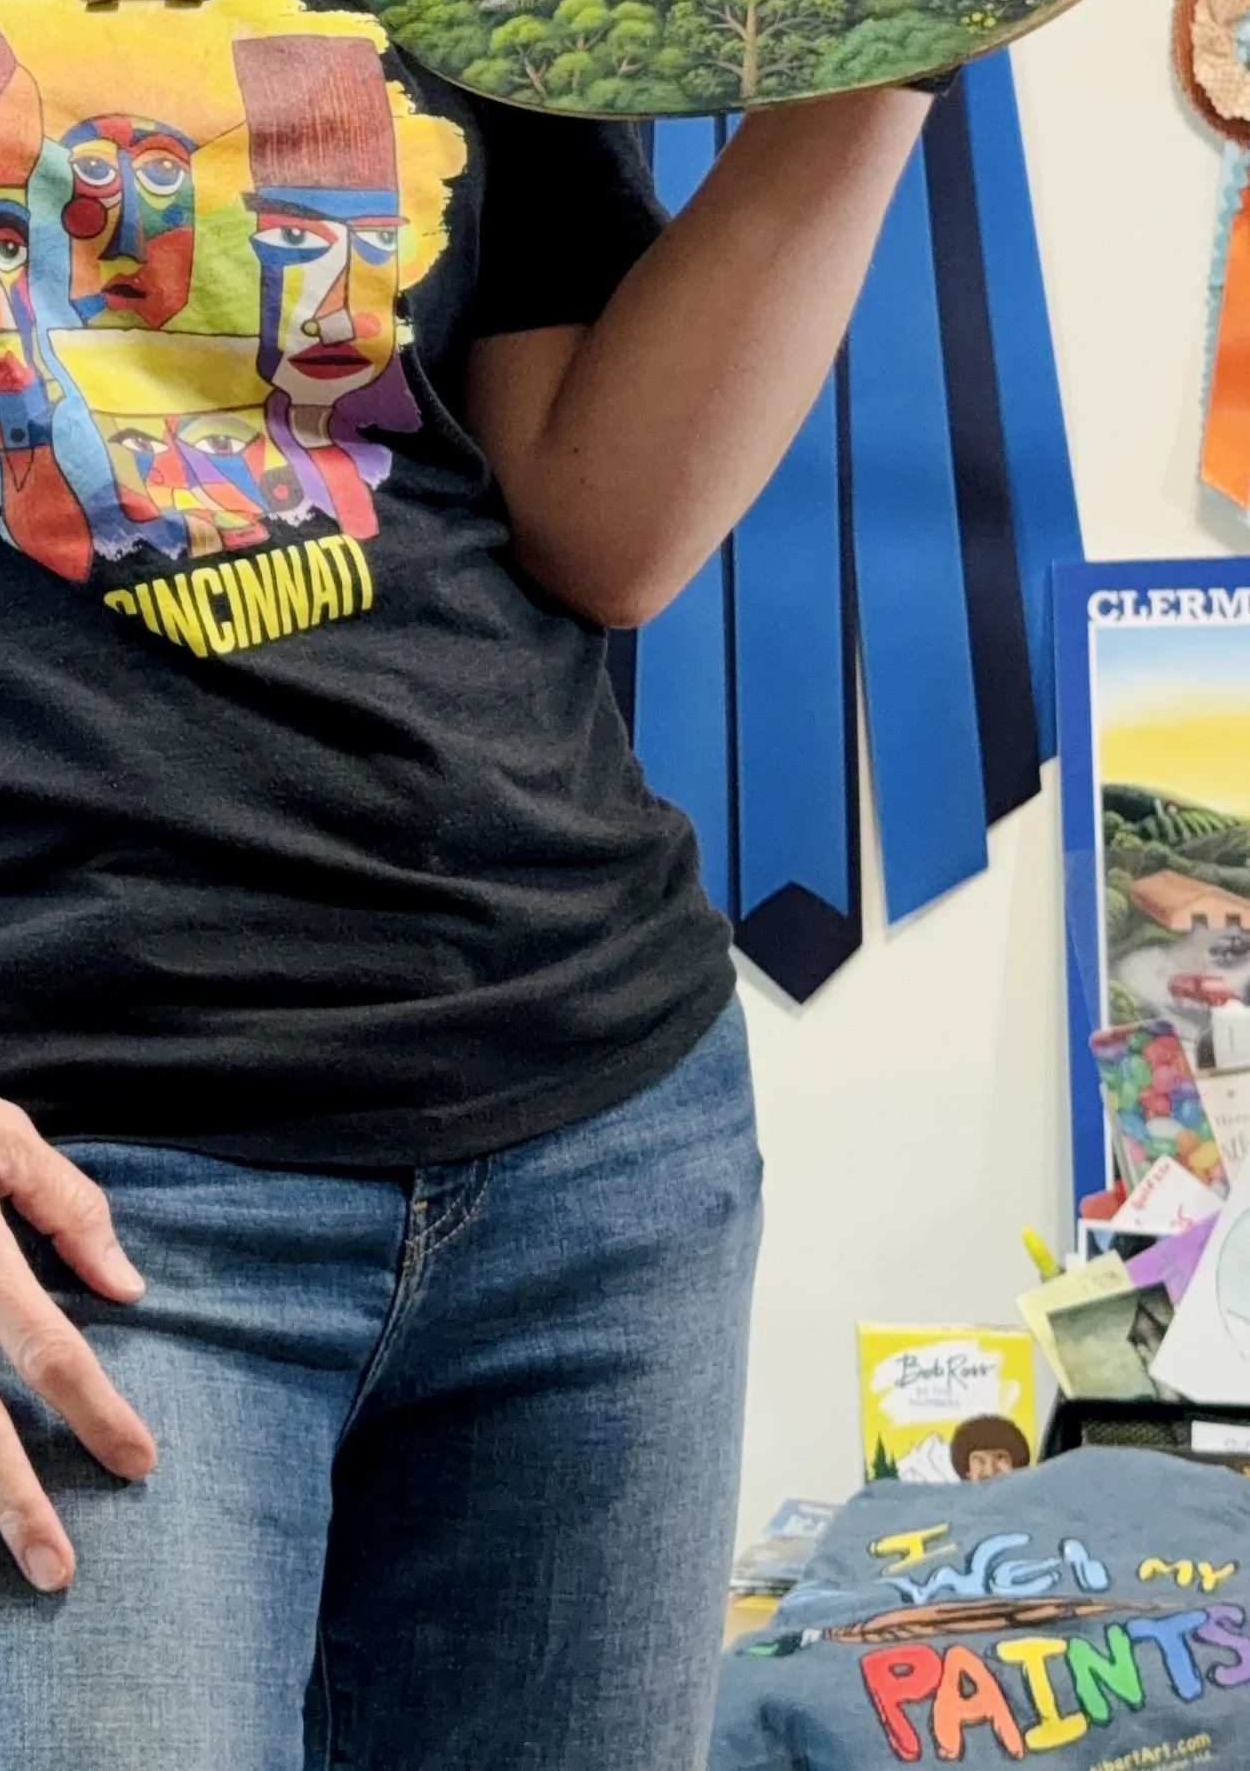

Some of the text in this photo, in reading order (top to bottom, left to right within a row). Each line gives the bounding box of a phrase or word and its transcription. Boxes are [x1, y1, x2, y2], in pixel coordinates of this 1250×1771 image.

[894, 1352, 997, 1392] Bob Ross
[868, 1521, 958, 1576] I
[860, 1603, 1250, 1763] PAINTS
